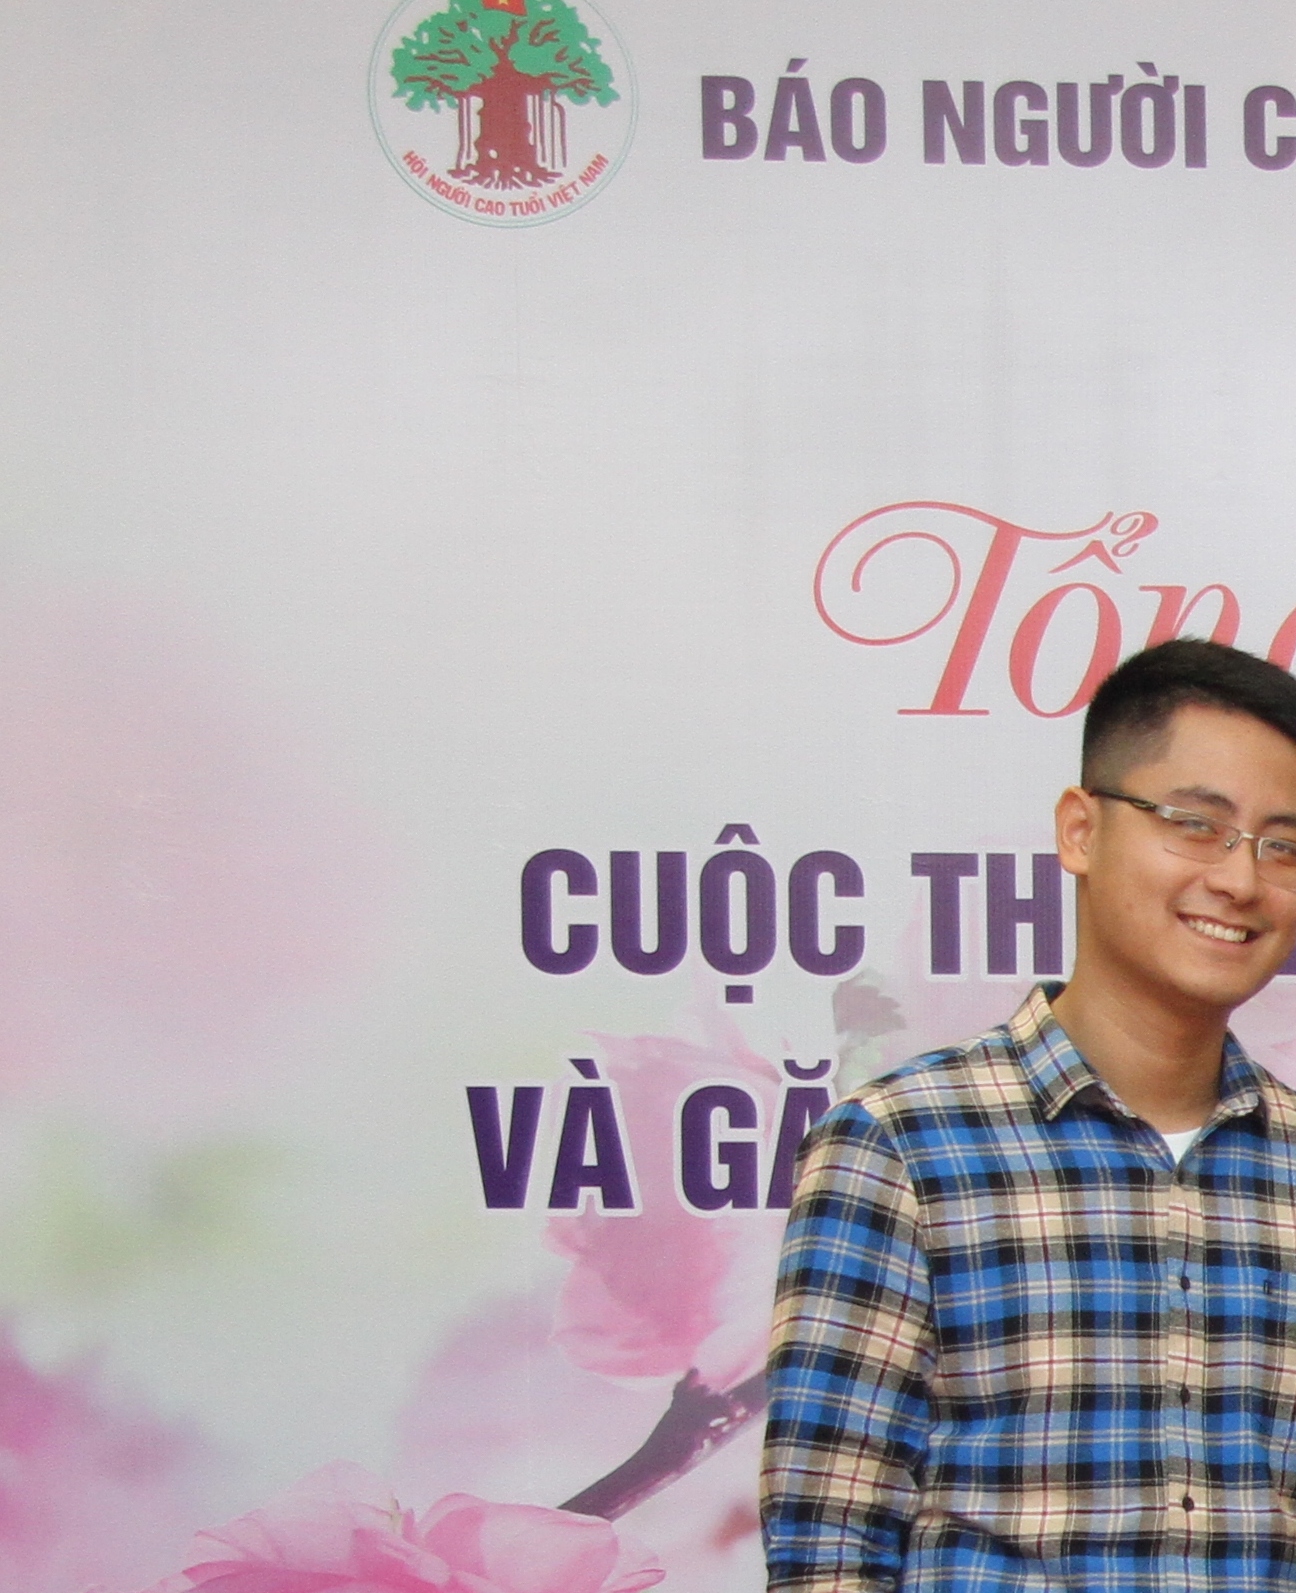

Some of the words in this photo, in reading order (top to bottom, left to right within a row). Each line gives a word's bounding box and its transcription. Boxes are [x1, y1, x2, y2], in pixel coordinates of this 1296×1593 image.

[704, 59, 885, 161] BÁO
[926, 62, 1206, 167] NGƯỜI
[474, 197, 505, 216] CAO
[578, 153, 610, 187] NAM
[522, 823, 866, 1004] CUỘC
[911, 852, 1063, 975] TH
[467, 1057, 635, 1210] VÀ
